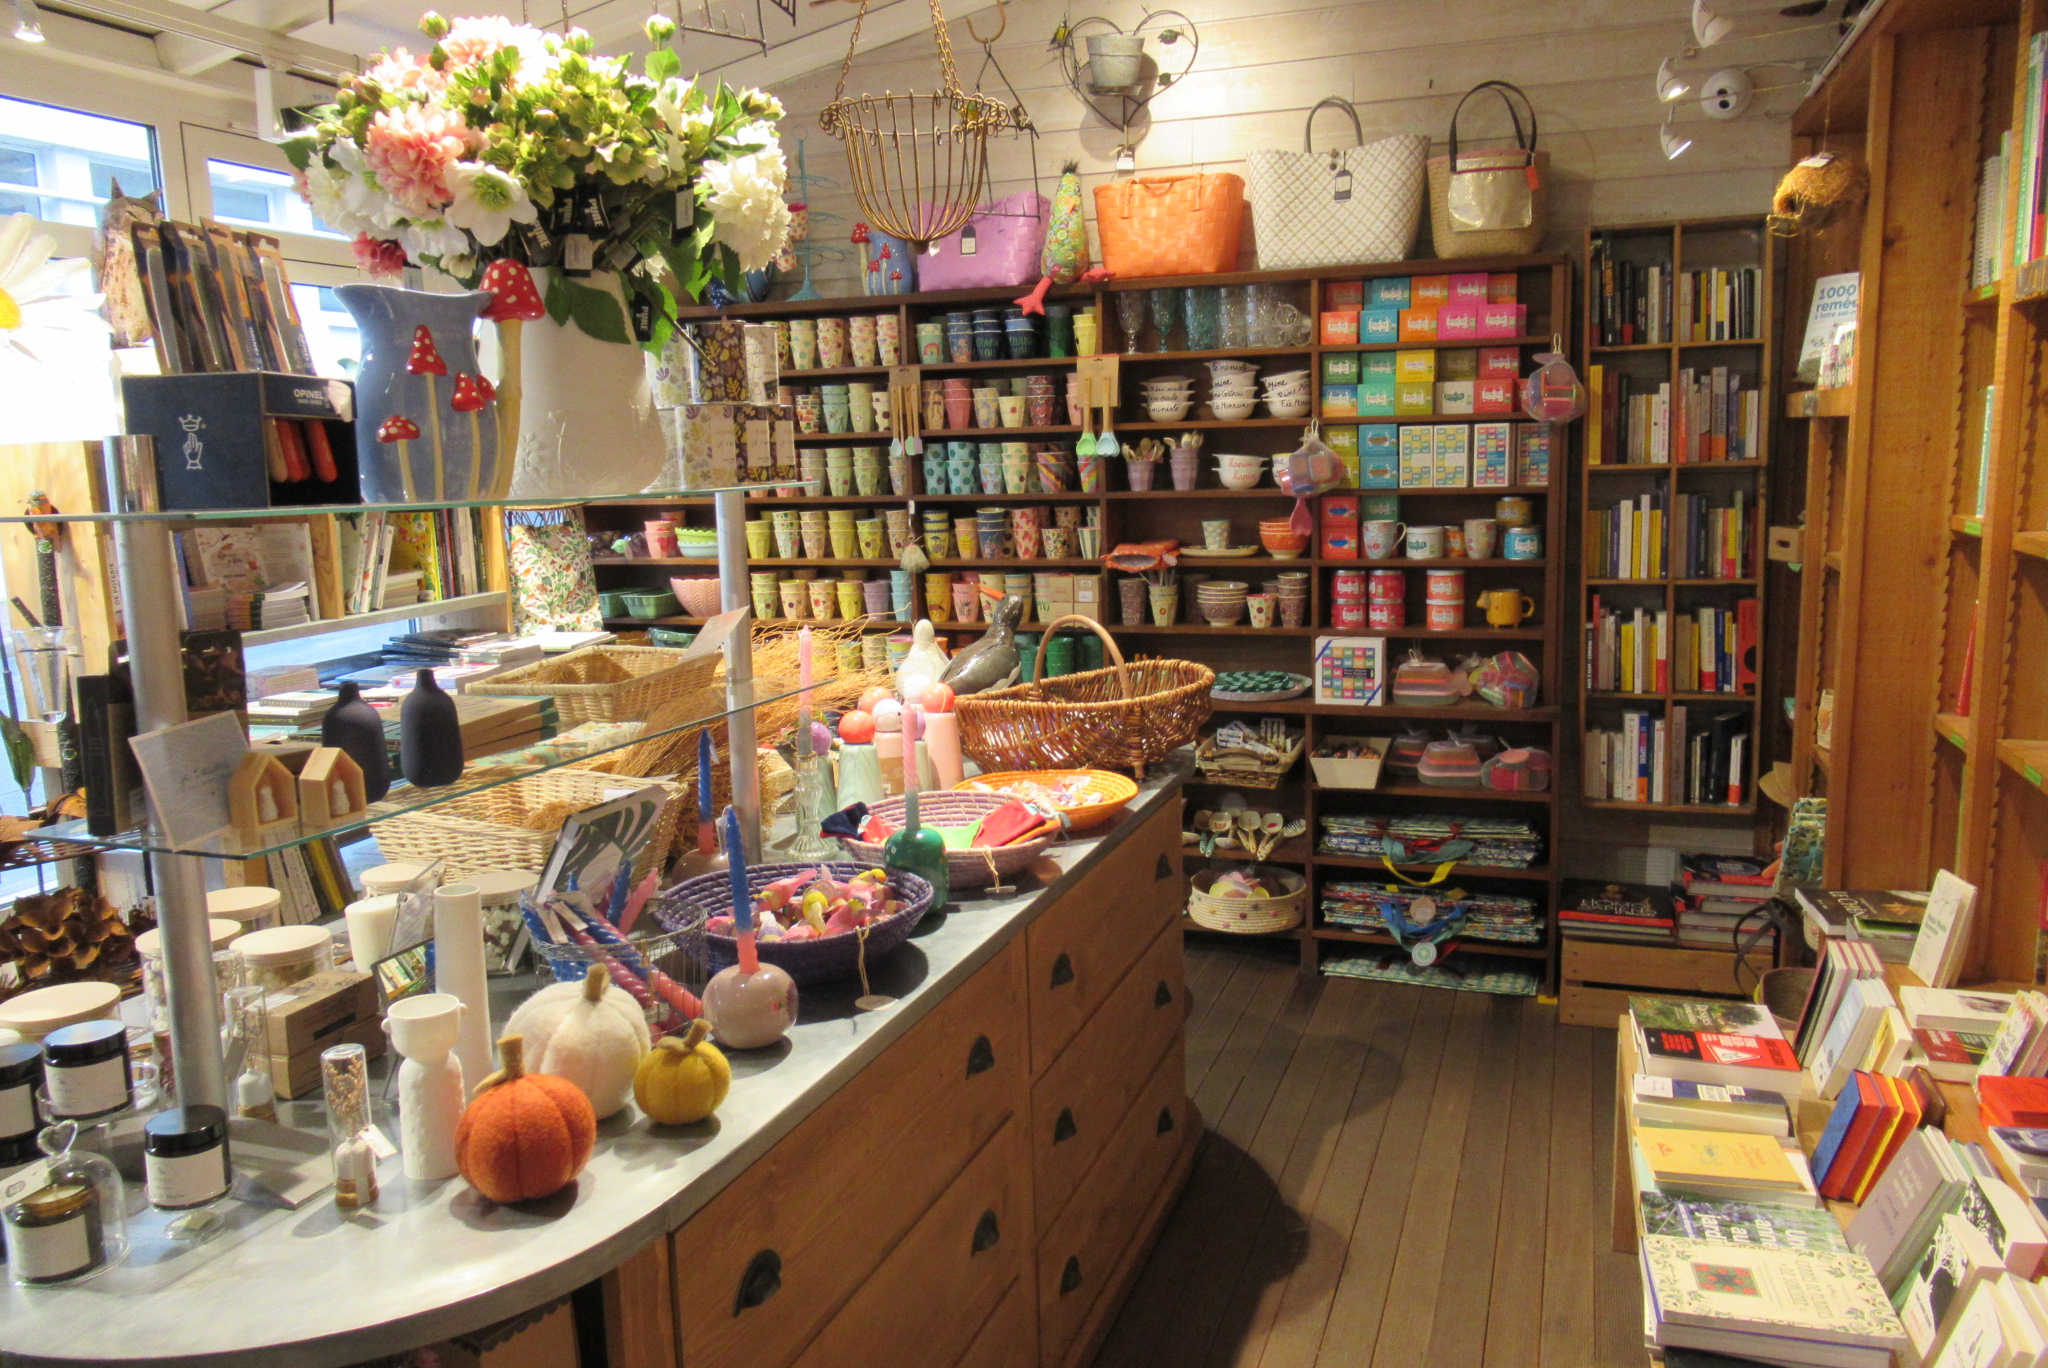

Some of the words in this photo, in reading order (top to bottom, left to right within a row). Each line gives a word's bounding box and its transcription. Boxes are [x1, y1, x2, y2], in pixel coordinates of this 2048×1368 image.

[588, 198, 604, 227] PURE
[1818, 284, 1857, 301] 1000
[640, 305, 649, 331] PURE
[294, 389, 325, 399] OPINEL
[1227, 458, 1252, 468] lapin
[1233, 470, 1256, 484] lapin
[109, 563, 118, 594] POTERIE
[113, 595, 120, 605] DE
[1730, 1227, 1750, 1244] au
[1784, 1229, 1808, 1249] Un
